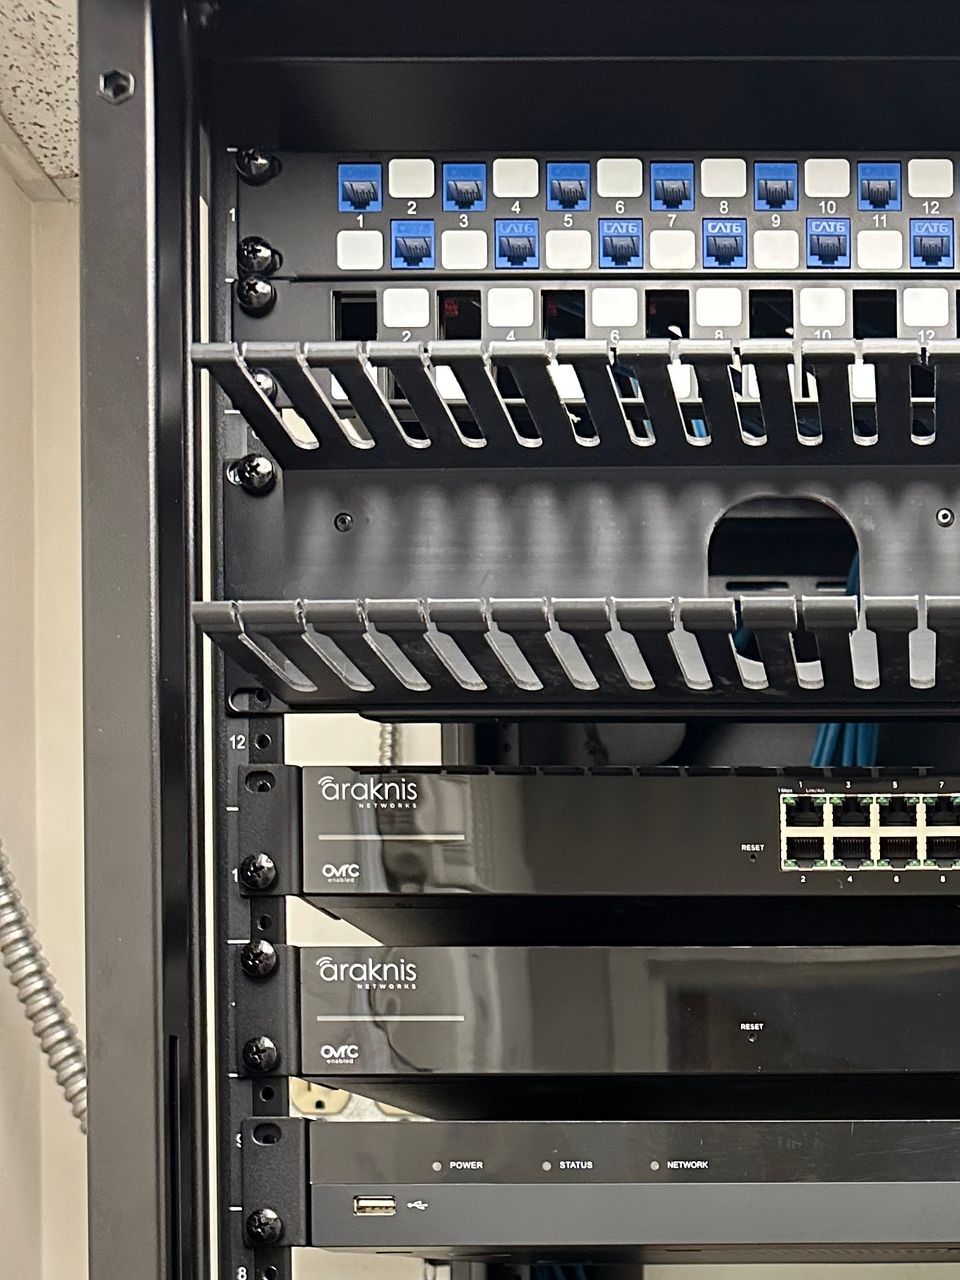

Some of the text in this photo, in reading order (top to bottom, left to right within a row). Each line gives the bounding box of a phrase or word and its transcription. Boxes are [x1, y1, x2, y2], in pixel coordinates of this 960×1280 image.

[408, 201, 416, 214] 2
[511, 201, 520, 214] 4
[616, 201, 624, 214] 6
[720, 201, 728, 214] 8
[819, 201, 836, 214] 10
[923, 201, 939, 214] 12
[230, 208, 235, 222] 1
[357, 215, 363, 227] 1
[459, 214, 468, 227] 3
[564, 214, 572, 227] 5
[668, 214, 676, 227] 7
[772, 214, 780, 227] 9
[873, 215, 886, 227] 11
[230, 735, 245, 749] 12
[318, 776, 417, 800] araknis
[316, 957, 416, 982] araknis
[238, 1267, 246, 1280] 8
